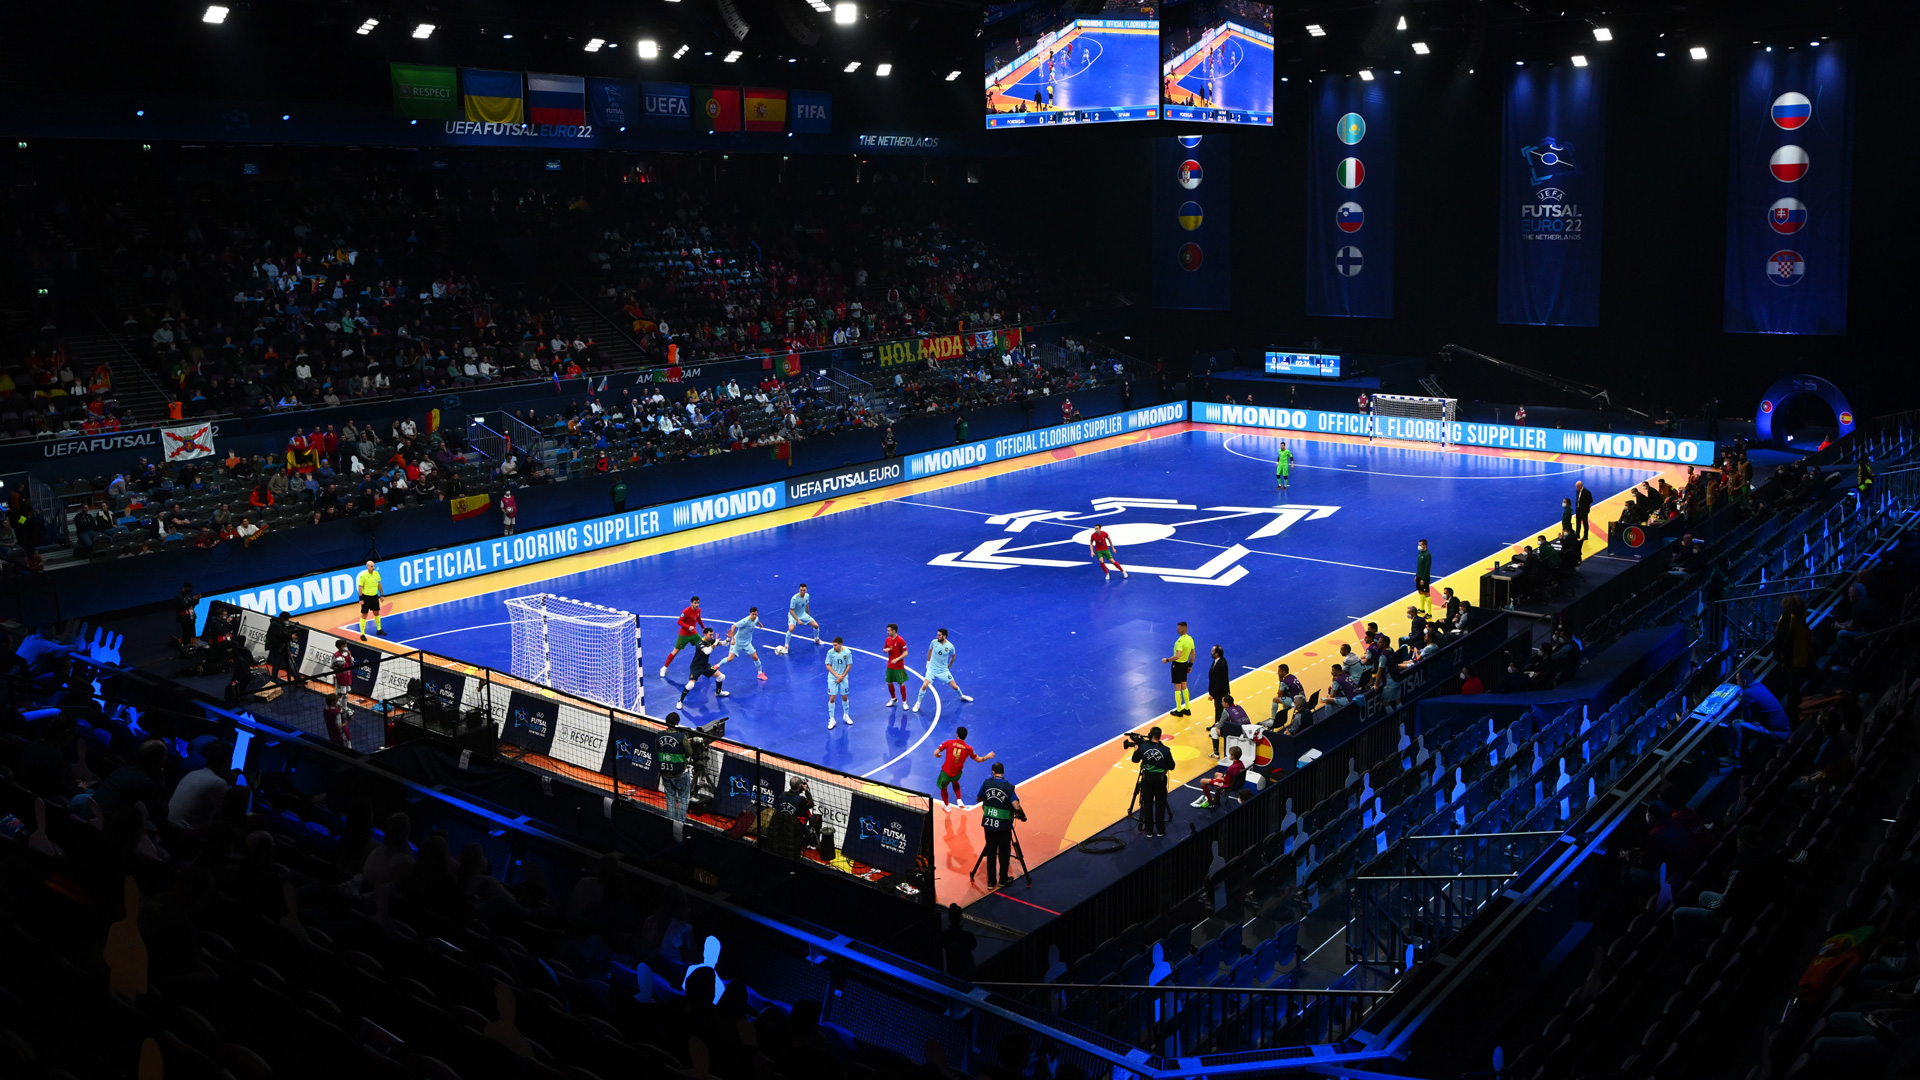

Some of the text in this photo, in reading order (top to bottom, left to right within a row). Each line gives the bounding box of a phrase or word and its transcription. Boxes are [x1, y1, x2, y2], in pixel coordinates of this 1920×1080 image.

[412, 87, 451, 98] RESPECT
[645, 97, 688, 114] UEFA
[797, 104, 826, 120] FIFA
[1094, 113, 1099, 121] 2
[445, 121, 592, 138] UEFA FUTSAL EURO 22
[860, 135, 877, 146] THE
[1537, 189, 1564, 201] UEFA
[1521, 204, 1582, 217] FUTSAL
[1521, 219, 1582, 232] EURO 22
[879, 335, 964, 367] HOLANDA
[924, 403, 1183, 474] MONDO OFFICIAL FLOORING SUPPLIER MONDO
[1222, 405, 1698, 463] MONDO OFFICIAL FLOORING SUPPLIER MONDO
[43, 440, 89, 458] UEFA
[90, 433, 156, 451] FUTSAL
[790, 464, 900, 499] UEFA FUTSAL EURO
[239, 487, 777, 616] MOND OFFICIAL FLOORING SUPPLIER MONDO
[1453, 645, 1463, 667] 22
[530, 717, 547, 727] FUTSAL
[570, 731, 603, 749] RESPECT
[660, 737, 677, 748] UEFA
[633, 748, 652, 760] FUTSAL
[952, 747, 962, 764] 4
[645, 759, 652, 767] 22
[660, 763, 674, 771] 513
[985, 789, 1006, 801] UEFA
[812, 804, 848, 824] ESPECT
[987, 808, 998, 817] HB
[984, 817, 1000, 828] 218
[882, 828, 907, 842] FUTSAL
[881, 836, 906, 850] EURO 22
